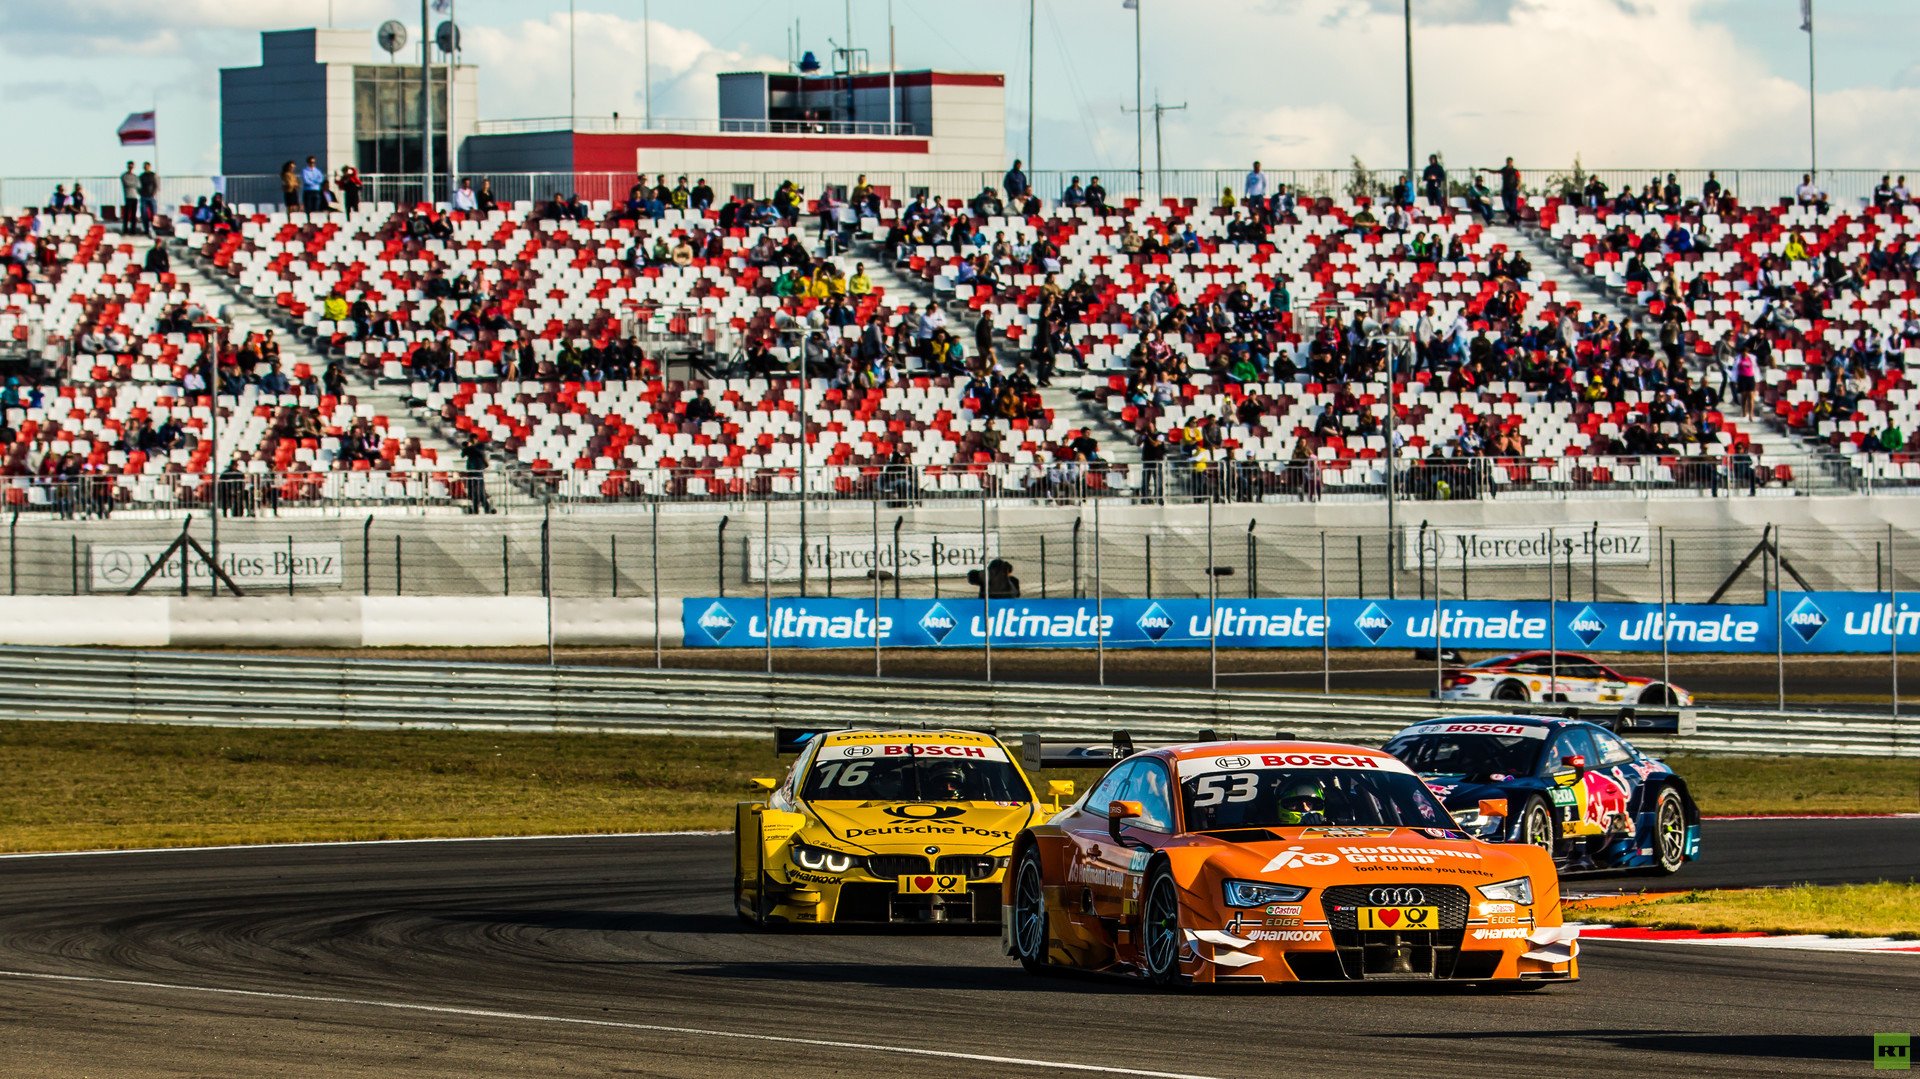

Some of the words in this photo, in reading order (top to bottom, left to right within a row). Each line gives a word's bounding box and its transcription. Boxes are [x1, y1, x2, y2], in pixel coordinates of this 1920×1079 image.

[1456, 531, 1642, 558] Mercedes-Benz
[749, 607, 893, 638] ultimate
[971, 607, 1114, 637] ultimate
[1189, 607, 1331, 636] ultimate
[1406, 609, 1546, 638] ultimate
[1620, 612, 1759, 642] ultimate
[1791, 613, 1823, 626] ARAL
[836, 732, 932, 741] Deutsche
[938, 733, 983, 742] Post
[1445, 725, 1524, 734] BOSCH
[884, 745, 986, 758] BOSCH
[1260, 754, 1379, 768] BOSCH
[819, 761, 875, 789] 16
[1193, 772, 1259, 807] 53
[1564, 805, 1572, 822] 5
[846, 825, 955, 839] Deutsche
[962, 826, 1012, 840] Post
[1337, 846, 1483, 859] Hoffmann
[1345, 853, 1436, 865] Group
[1354, 865, 1384, 873] Tools
[1401, 865, 1433, 873] make
[1436, 866, 1456, 874] you
[1458, 867, 1494, 878] better
[906, 876, 911, 892] I
[1273, 905, 1300, 915] Castrol
[1265, 918, 1300, 926] EDGE
[1368, 908, 1374, 928] I
[1491, 916, 1516, 924] EDGE
